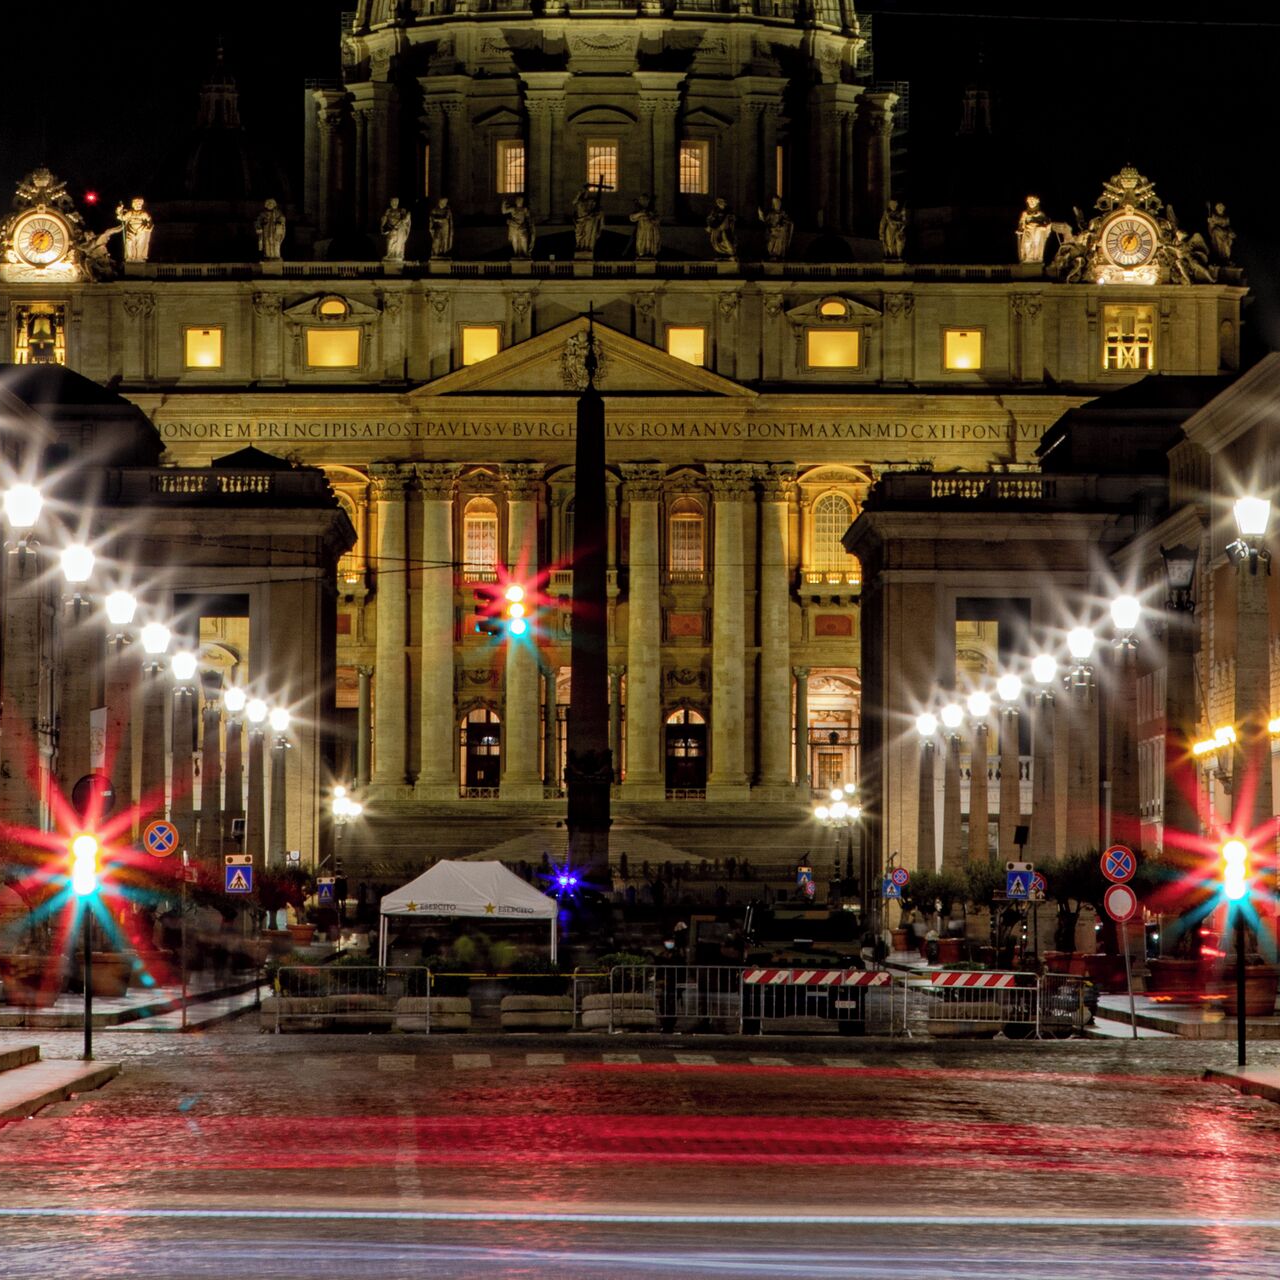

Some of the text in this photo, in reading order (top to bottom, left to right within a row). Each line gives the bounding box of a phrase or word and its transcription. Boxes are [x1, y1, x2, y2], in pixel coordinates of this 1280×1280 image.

[257, 422, 358, 438] PRINCIPIS
[361, 422, 426, 438] APOST
[426, 422, 492, 438] PAVLVS
[640, 422, 742, 438] ROMANVS
[876, 423, 956, 439] MDCXII
[419, 903, 457, 911] ESERCITO
